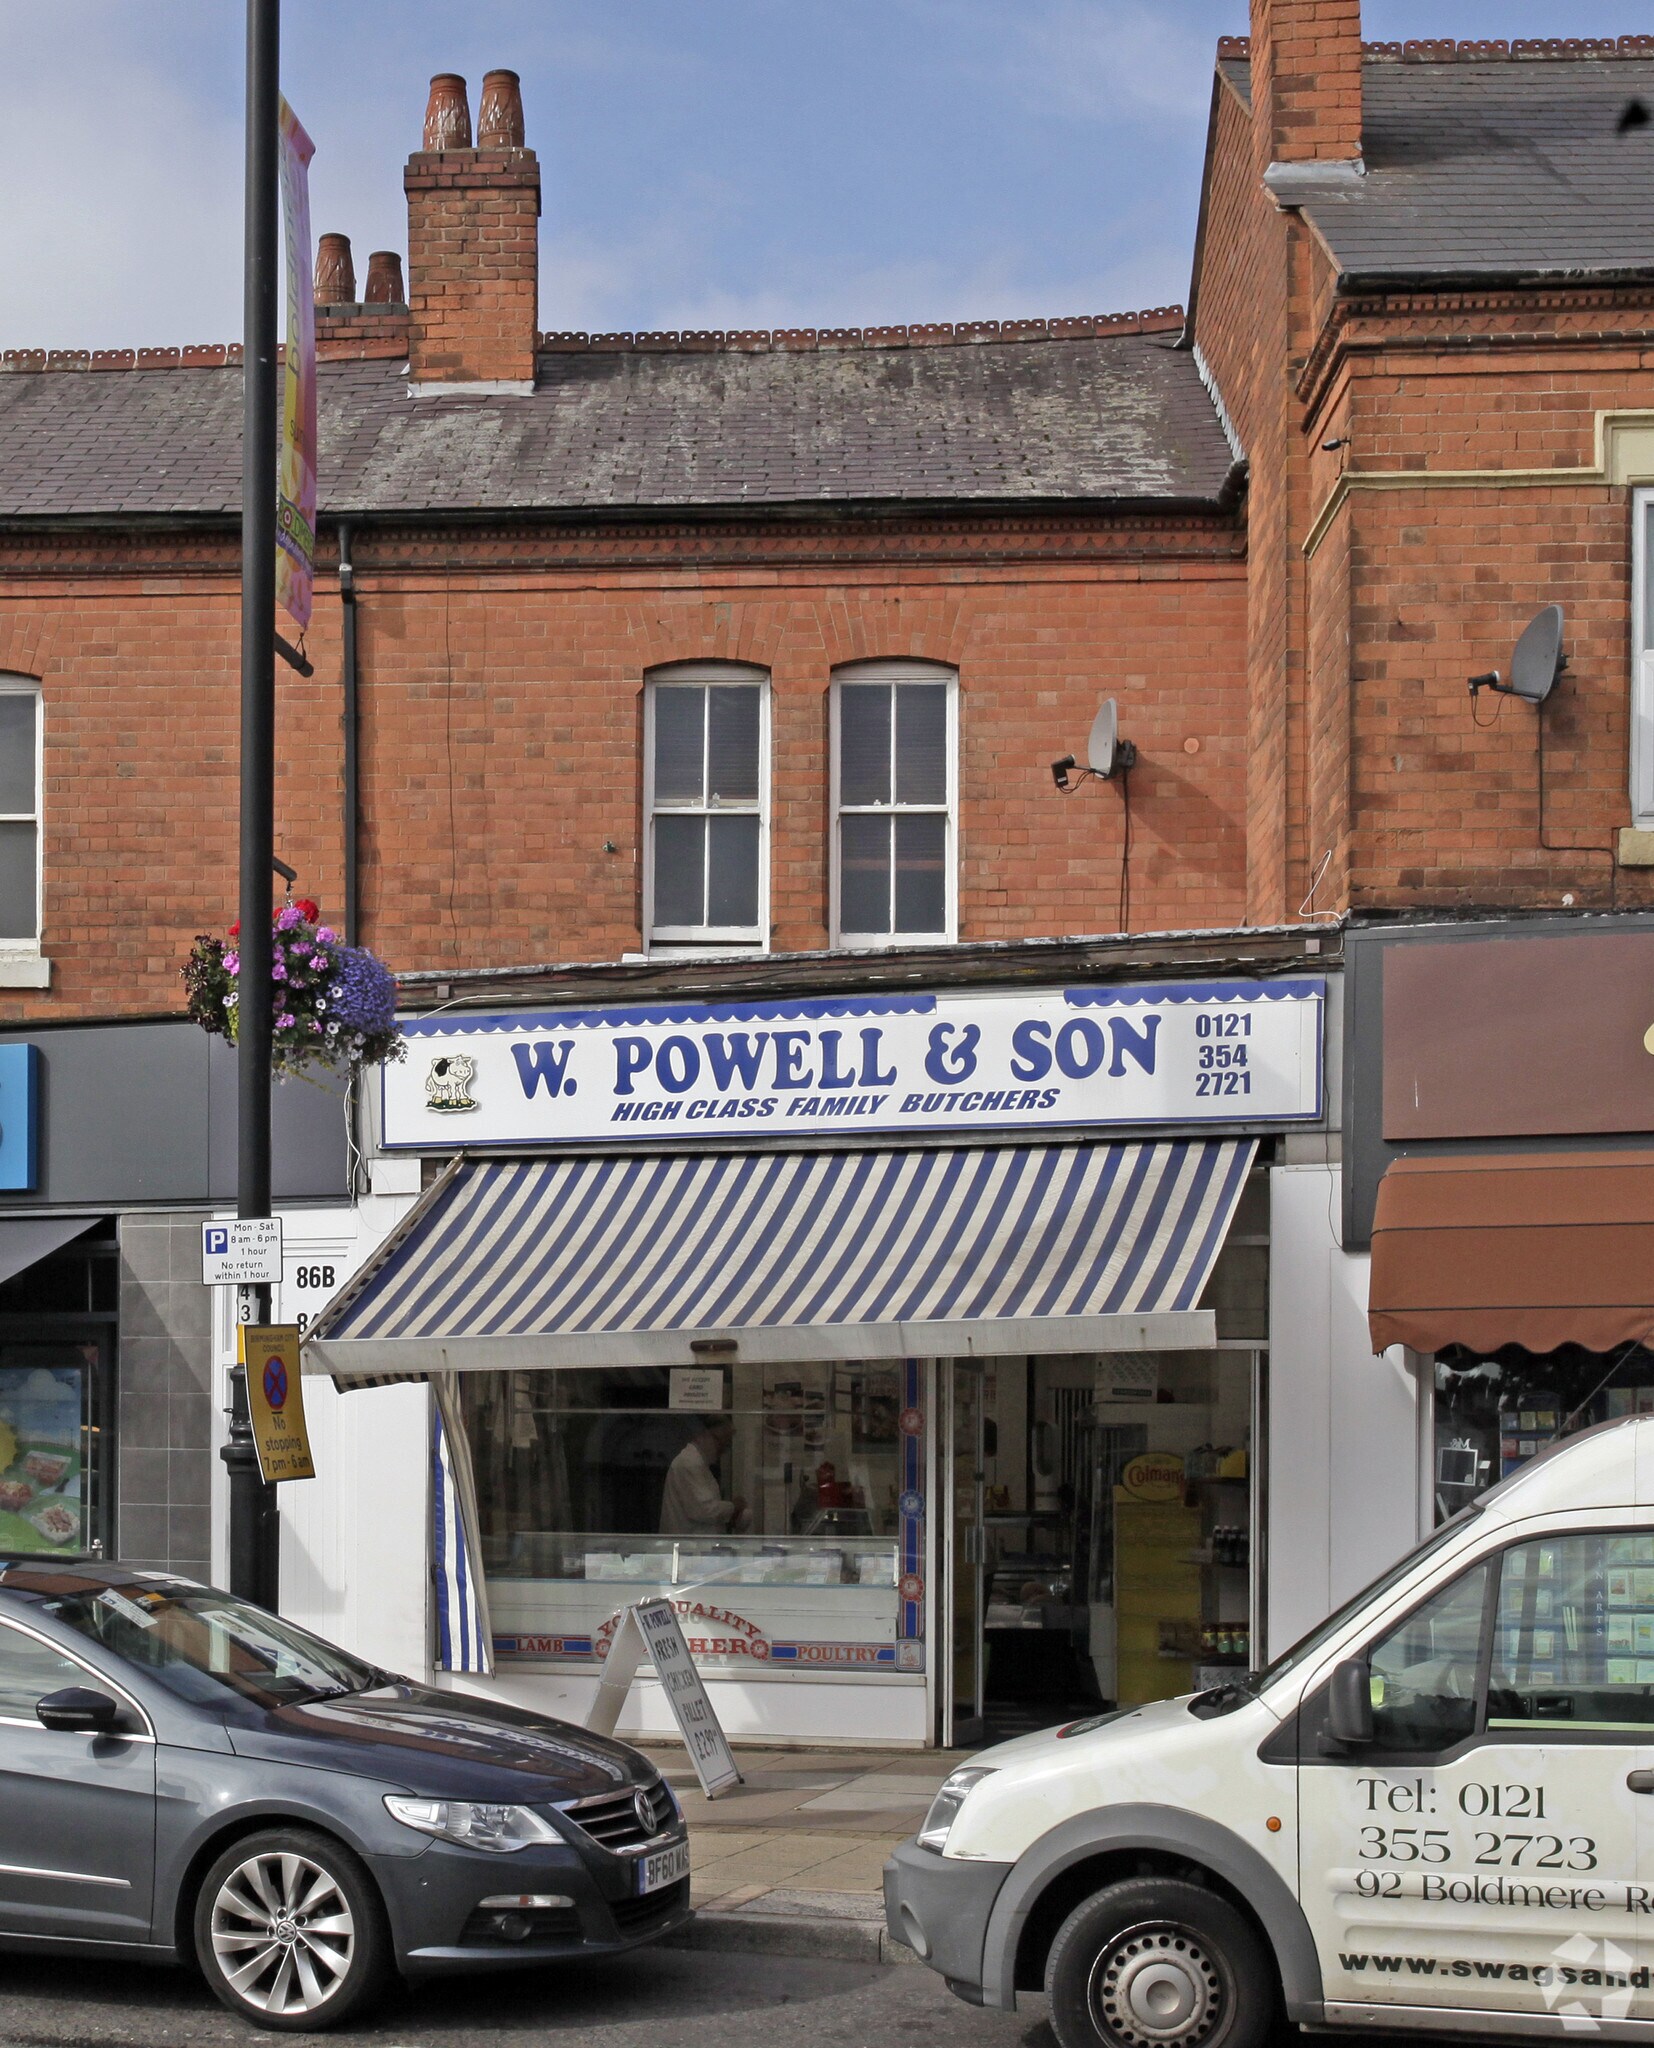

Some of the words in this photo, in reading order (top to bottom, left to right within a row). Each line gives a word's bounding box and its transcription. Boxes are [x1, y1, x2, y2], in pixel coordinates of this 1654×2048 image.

[1195, 1013, 1252, 1037] 0121
[510, 1039, 578, 1100] W.
[612, 1027, 898, 1096] POWELL
[924, 1021, 982, 1086] &
[1010, 1013, 1163, 1083] SON
[1199, 1044, 1248, 1068] 354
[1195, 1071, 1252, 1097] 2721
[610, 1100, 684, 1122] HIGH
[685, 1097, 778, 1119] CLASS
[785, 1094, 890, 1117] FAMILY
[898, 1087, 1061, 1113] BUTCHERS
[234, 1223, 252, 1232] Mon
[259, 1222, 274, 1231] Sat
[210, 1231, 225, 1252] P
[230, 1235, 236, 1244] 8
[257, 1234, 263, 1243] 6
[264, 1235, 278, 1243] pm
[241, 1247, 245, 1255] 1
[247, 1247, 267, 1255] hour
[221, 1261, 233, 1269] No
[236, 1260, 263, 1269] return
[214, 1271, 241, 1280] within
[243, 1270, 247, 1279] 1
[250, 1270, 270, 1279] hour
[296, 1265, 336, 1289] 86B
[240, 1284, 251, 1300] 4
[240, 1304, 251, 1322] 3
[272, 1416, 286, 1431] No
[265, 1436, 302, 1453] stopping
[264, 1457, 271, 1473] 7
[272, 1457, 287, 1474] pm
[291, 1454, 297, 1469] 6
[297, 1456, 310, 1470] am
[517, 1638, 563, 1652] LAMB
[796, 1645, 879, 1661] POULTRY
[1356, 1778, 1437, 1814] Tel:
[1458, 1782, 1546, 1819] 0121
[1358, 1826, 1451, 1863] 355
[1473, 1832, 1598, 1871] 2723
[1355, 1869, 1404, 1899] 92
[1421, 1874, 1606, 1912] Boldmere
[1625, 1885, 1654, 1914] R
[1338, 1952, 1654, 1989] www.swagsand
